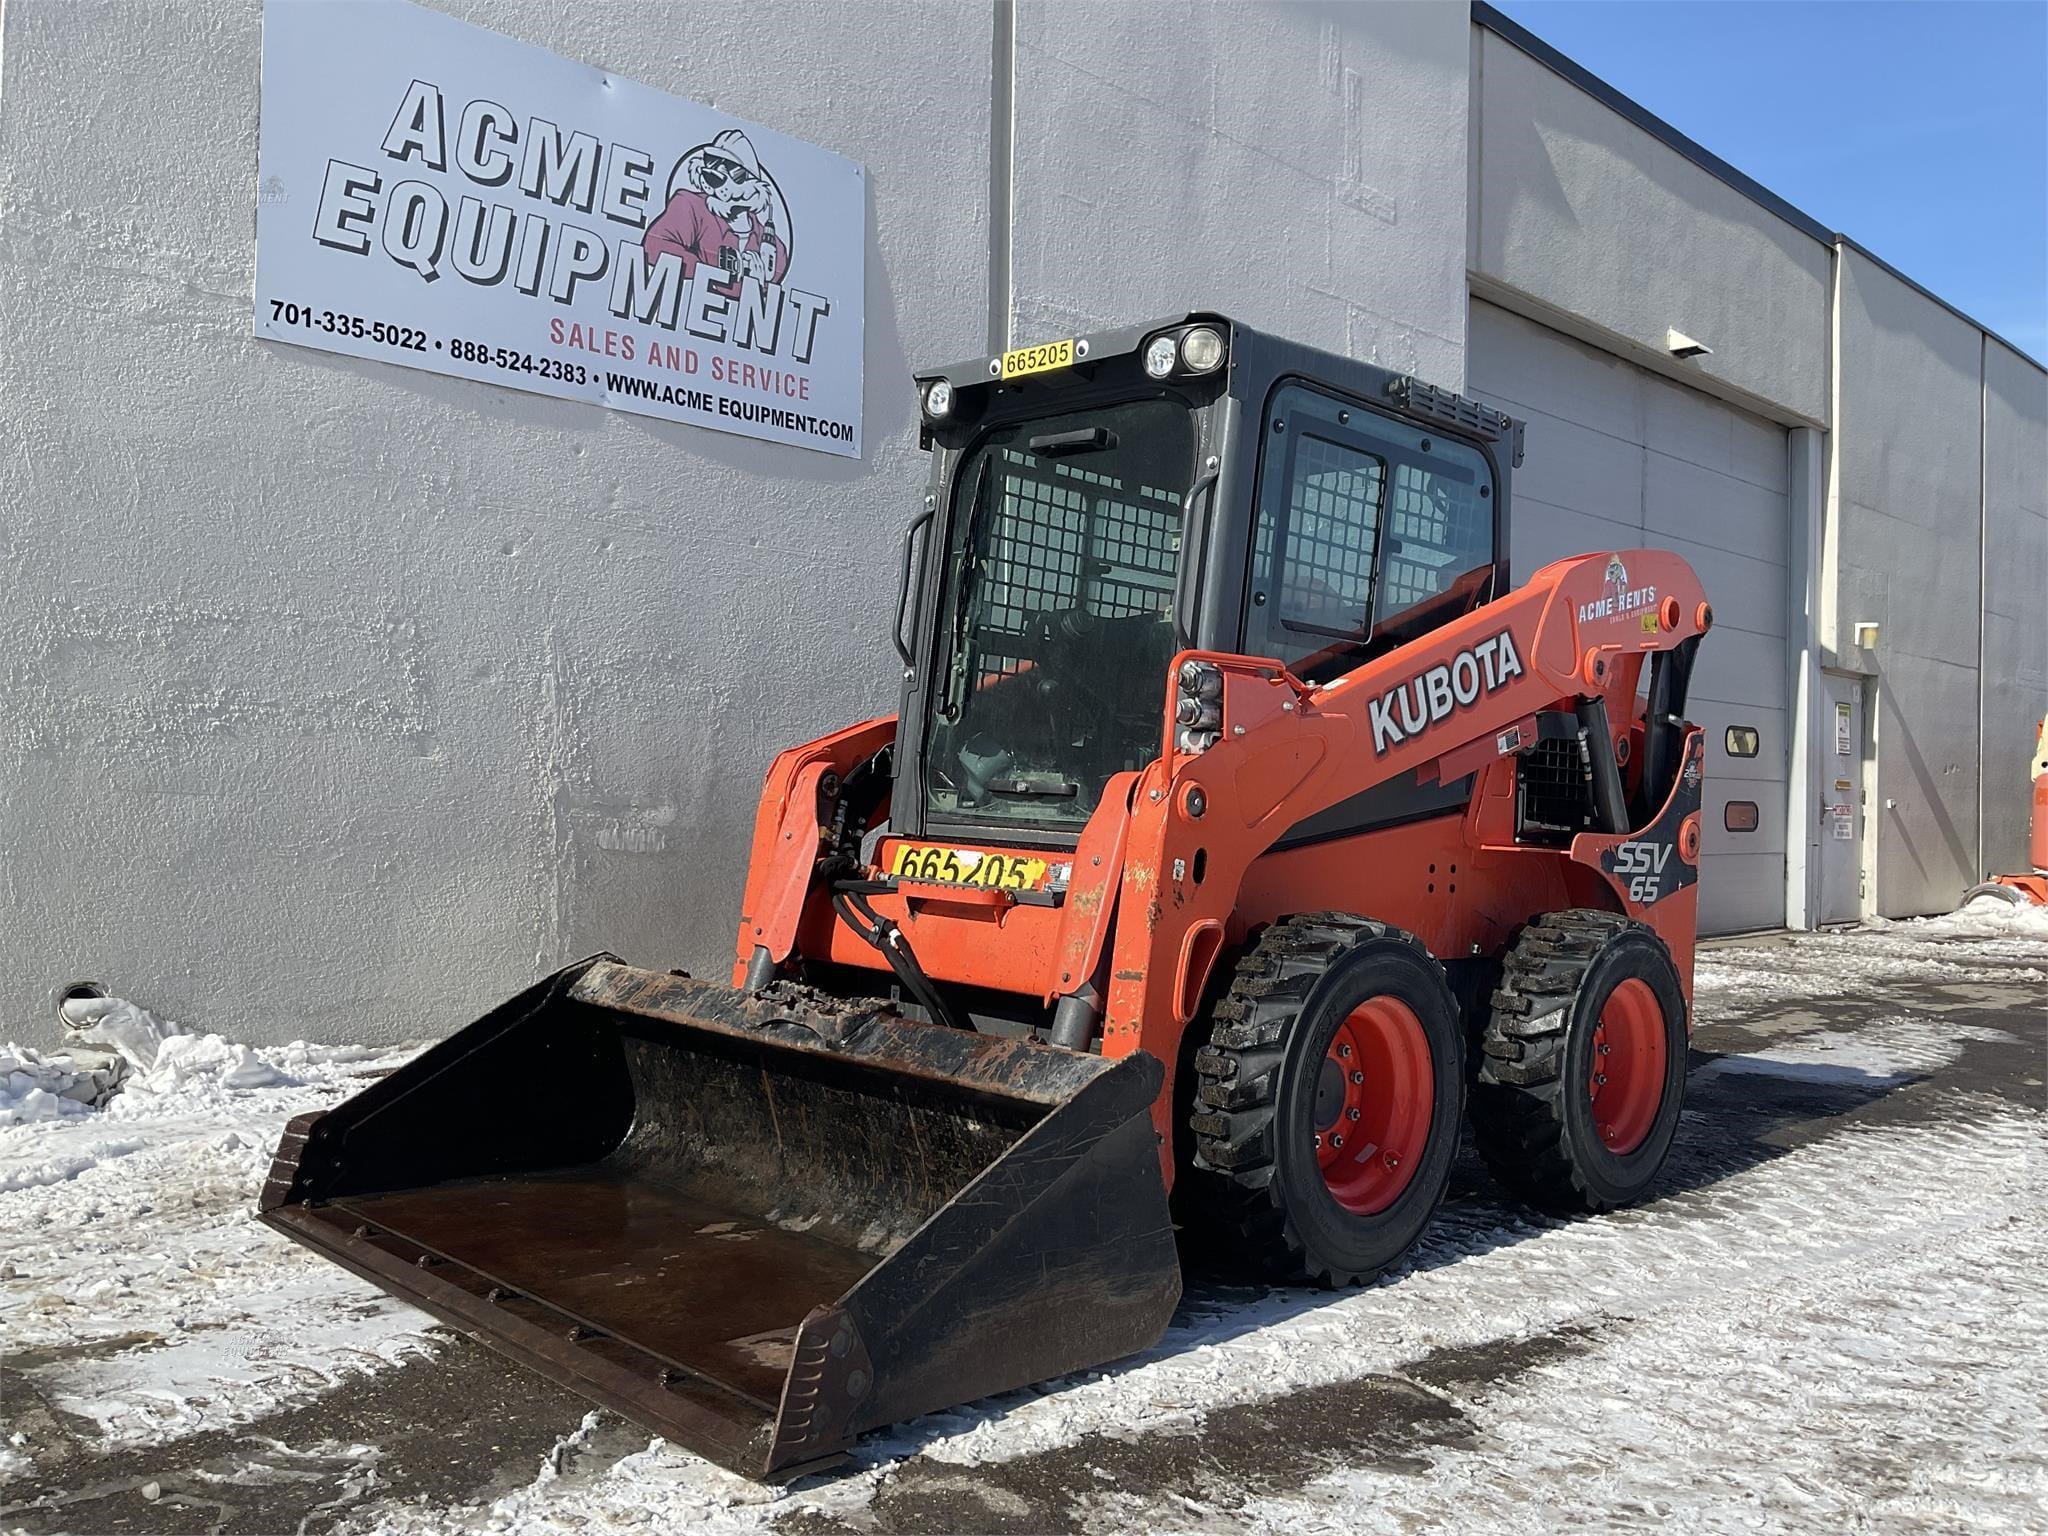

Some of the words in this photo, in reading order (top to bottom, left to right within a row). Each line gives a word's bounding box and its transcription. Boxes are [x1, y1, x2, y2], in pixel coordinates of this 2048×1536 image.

[381, 79, 654, 229] ACME
[312, 158, 830, 364] EQUIPMENT
[270, 299, 427, 352] 701-335-5022
[450, 338, 587, 385] 888-524-2383
[606, 372, 713, 412] WWW.ACME
[719, 397, 853, 442] EQUIPMENT.COM
[550, 318, 635, 361] SALES
[648, 341, 699, 375] AND
[711, 356, 810, 400] SERVICE
[1007, 343, 1068, 373] 665205
[1578, 598, 1613, 624] ACME
[1618, 585, 1655, 611] RENTS
[1368, 631, 1523, 754] KUBOTA
[900, 847, 1029, 888] 665205
[1613, 841, 1673, 874] SSV
[1629, 876, 1661, 902] 65
